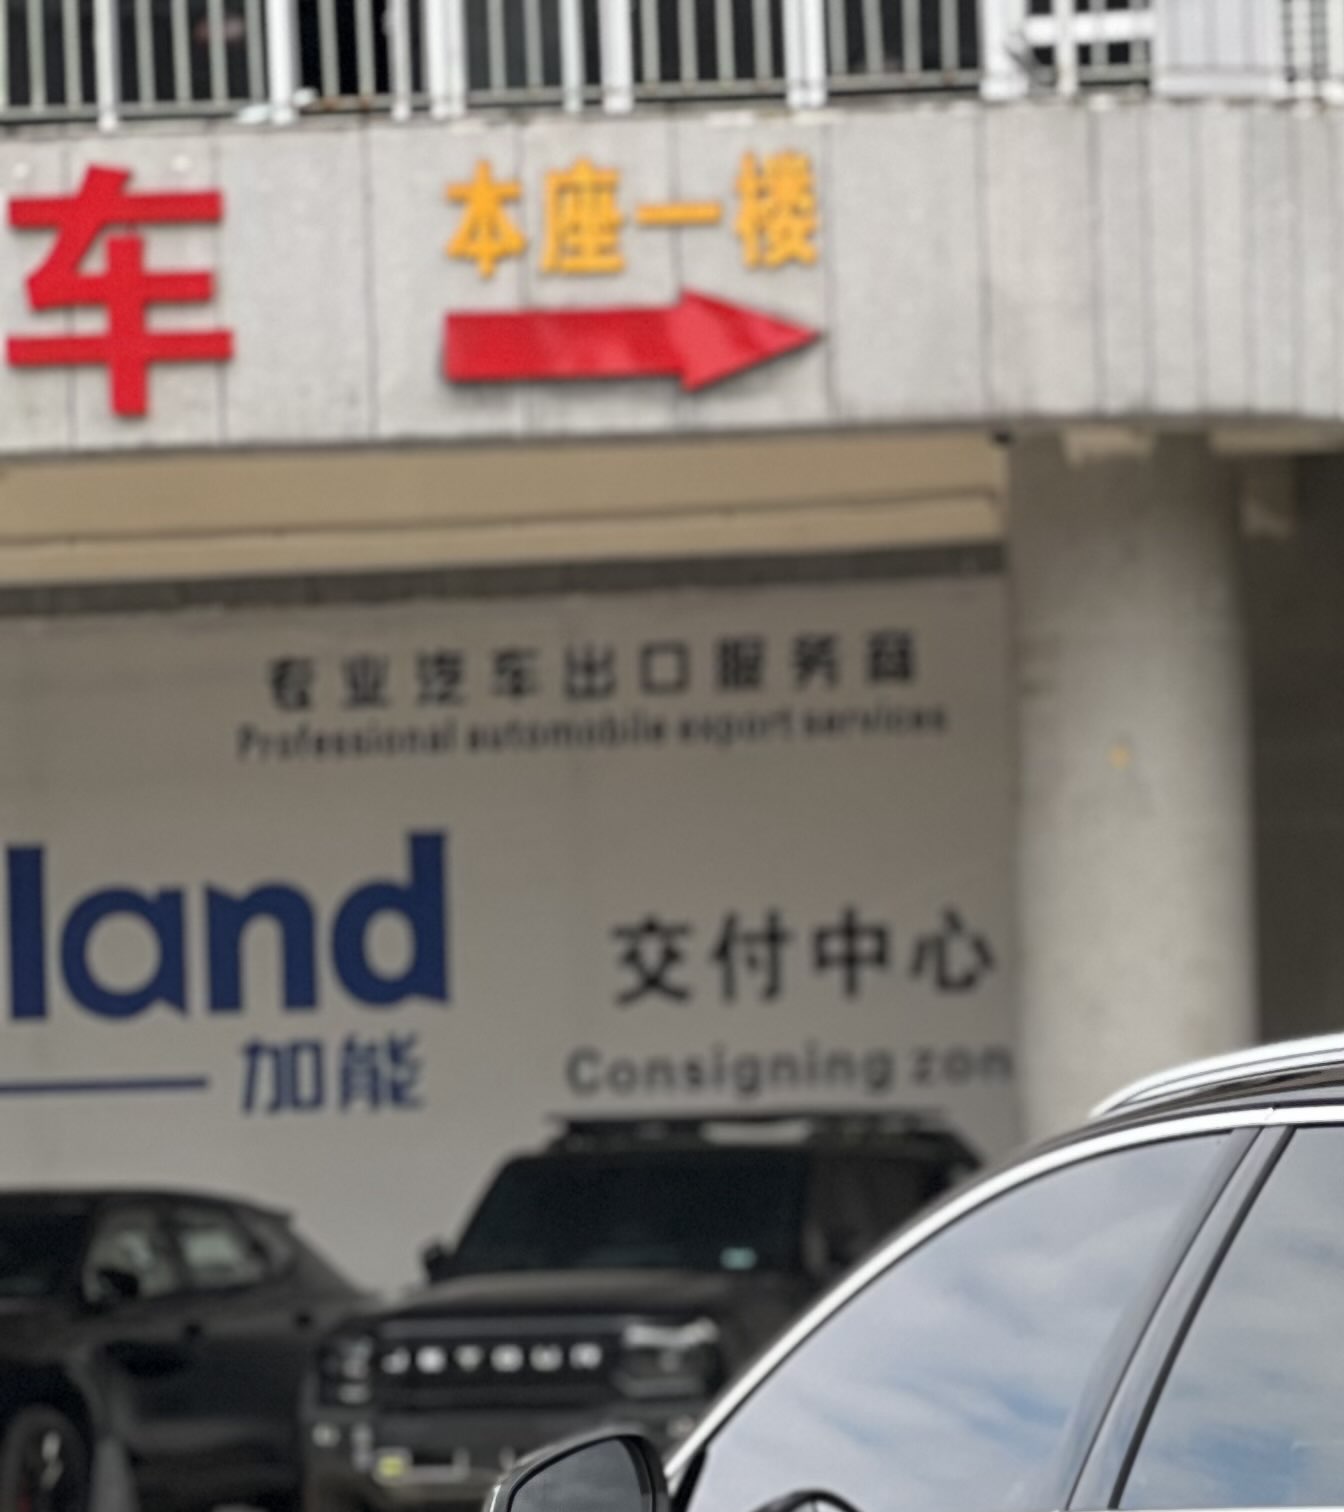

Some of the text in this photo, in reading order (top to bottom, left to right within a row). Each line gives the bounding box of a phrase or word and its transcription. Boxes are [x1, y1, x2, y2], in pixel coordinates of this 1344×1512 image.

[446, 150, 820, 280] 本座一楼
[6, 165, 234, 418] 车
[611, 905, 998, 1006] 交付中心
[241, 1033, 424, 1115] 加能
[565, 1040, 897, 1098] Consigning
